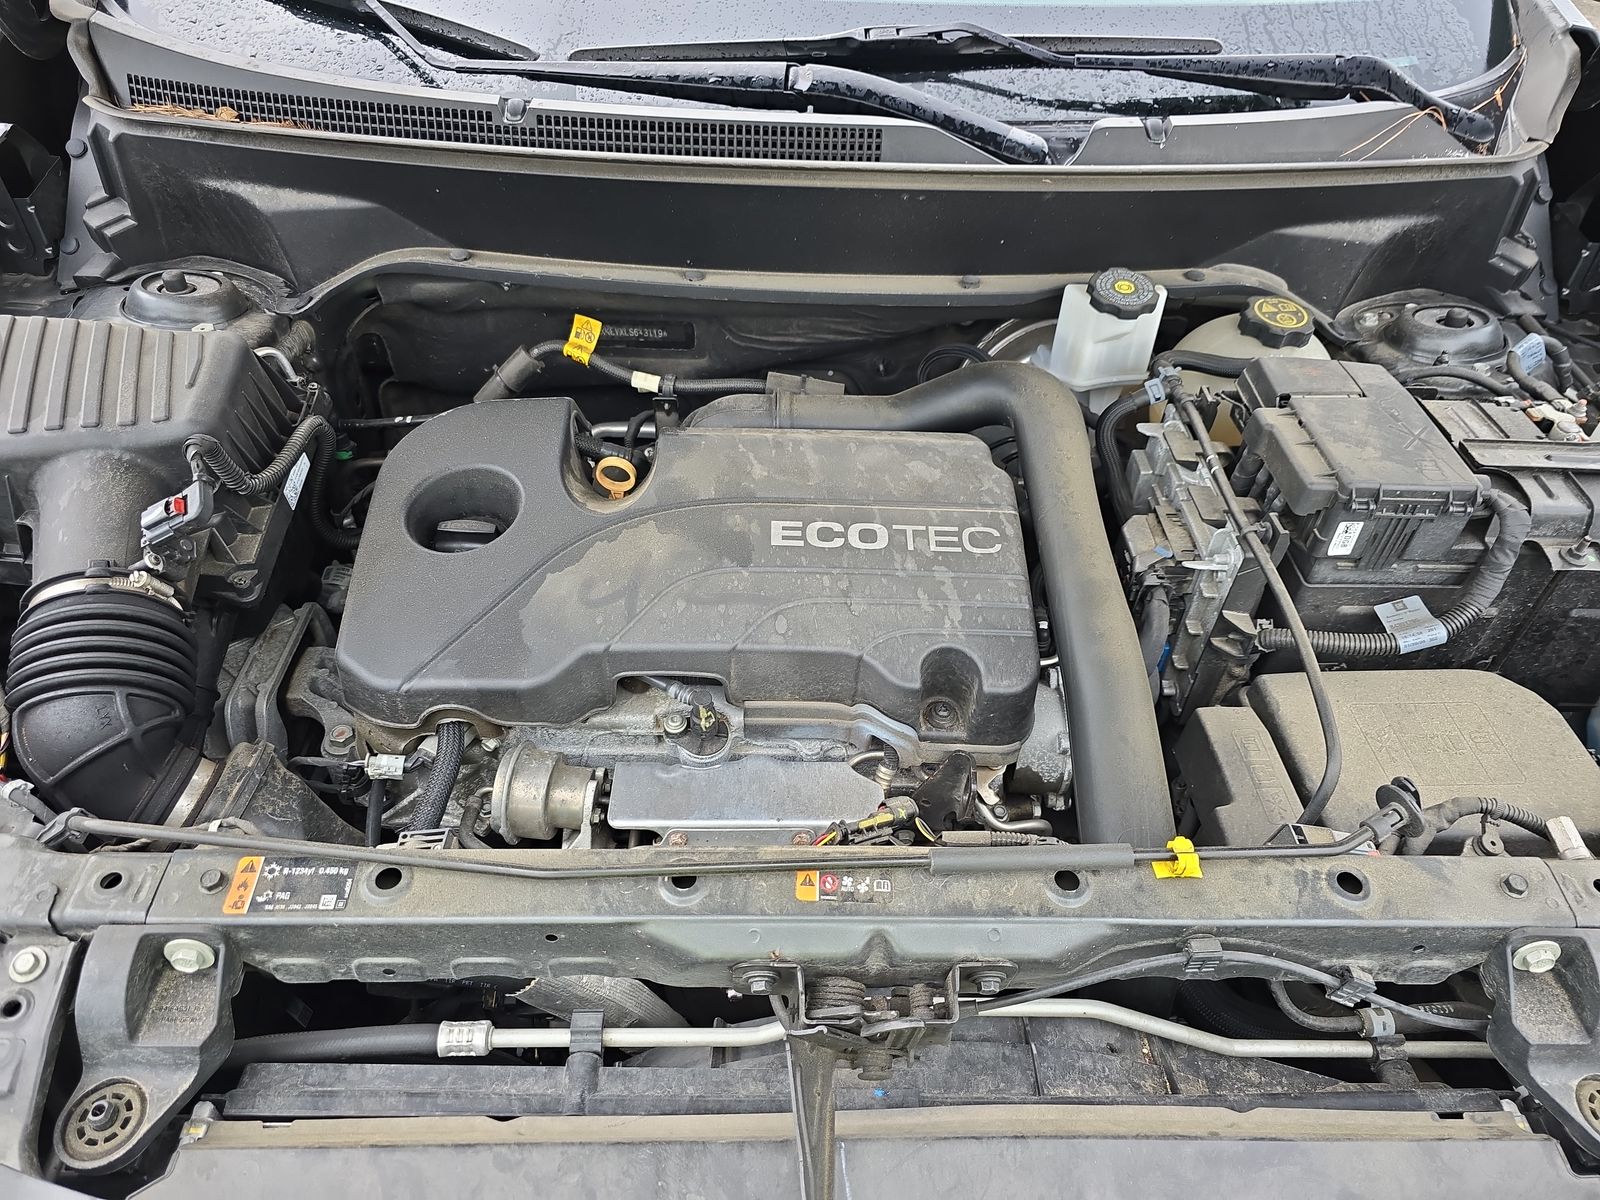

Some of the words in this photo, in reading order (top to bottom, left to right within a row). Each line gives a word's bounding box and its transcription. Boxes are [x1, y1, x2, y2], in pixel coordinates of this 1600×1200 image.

[770, 520, 1003, 554] ECOTEC
[339, 867, 349, 876] kg
[275, 891, 291, 900] PAG
